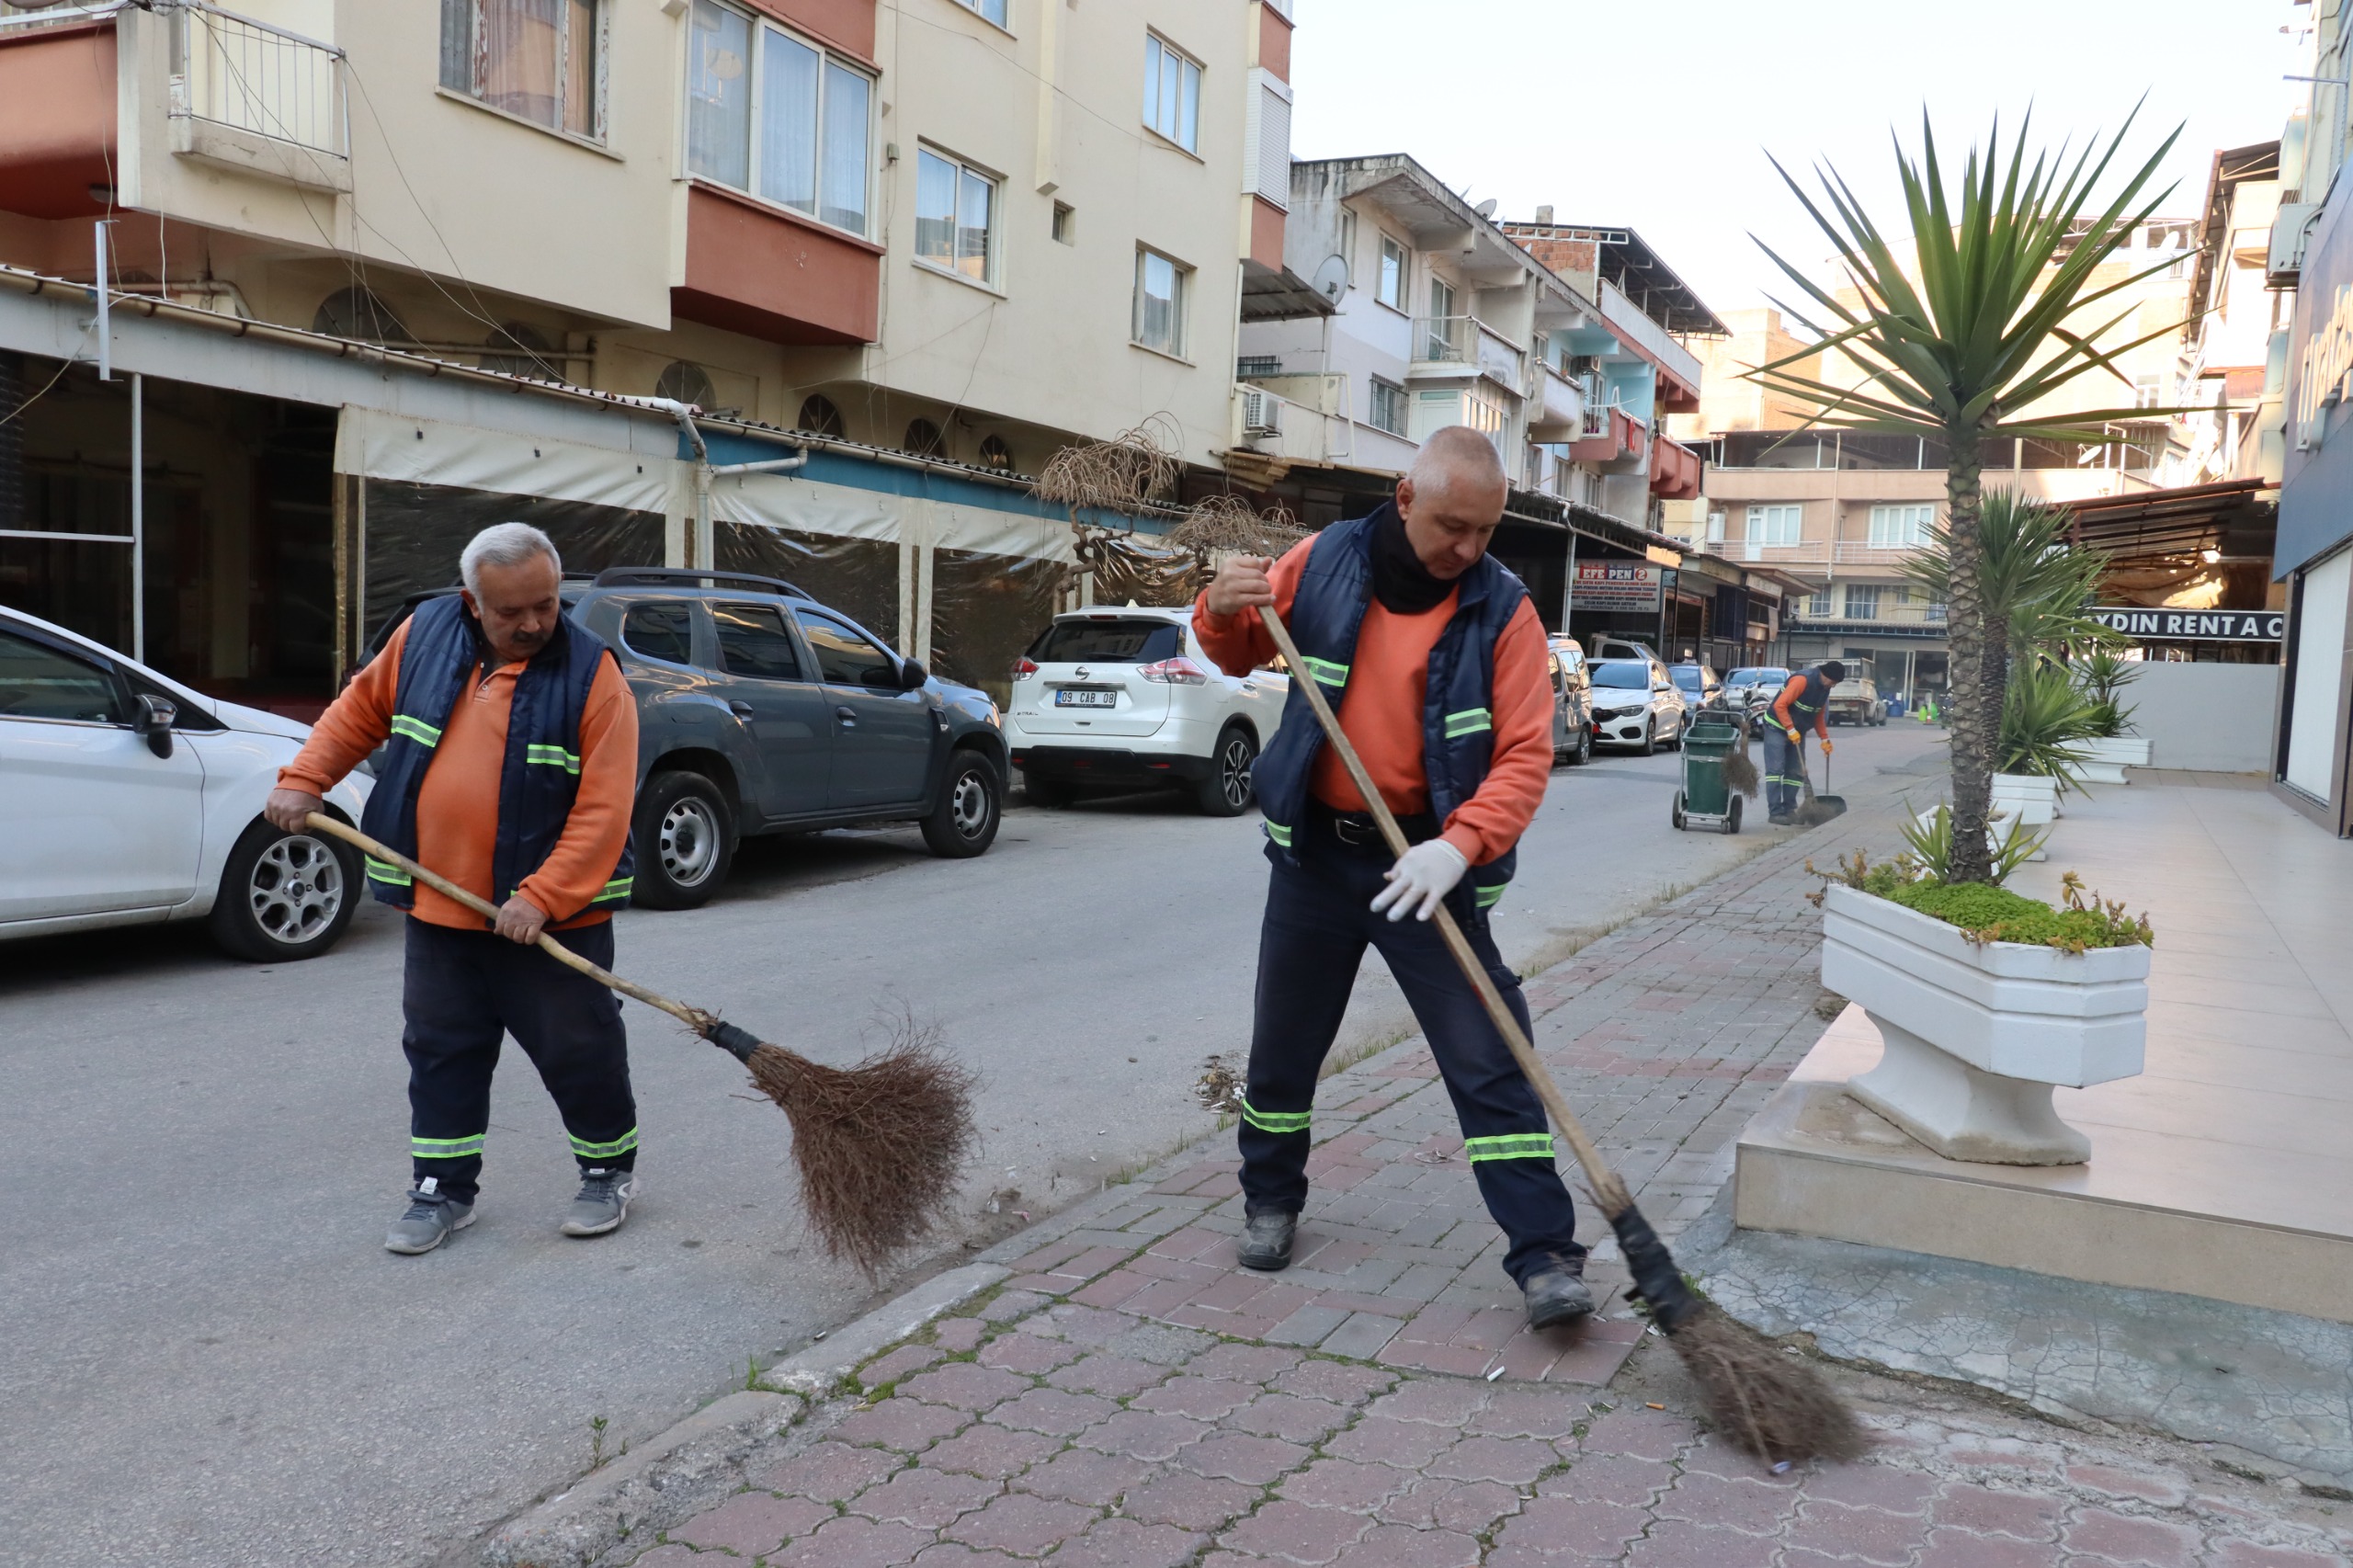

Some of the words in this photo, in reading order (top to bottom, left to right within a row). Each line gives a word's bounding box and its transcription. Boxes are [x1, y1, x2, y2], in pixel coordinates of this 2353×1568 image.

[1583, 569, 1605, 579] EFE
[1608, 569, 1632, 580] PEN
[2083, 613, 2158, 633] YDIN
[2166, 615, 2235, 635] RENT
[2240, 616, 2259, 637] A
[1062, 692, 1073, 703] 09
[1080, 692, 1096, 703] CAB
[1103, 693, 1114, 703] 08
